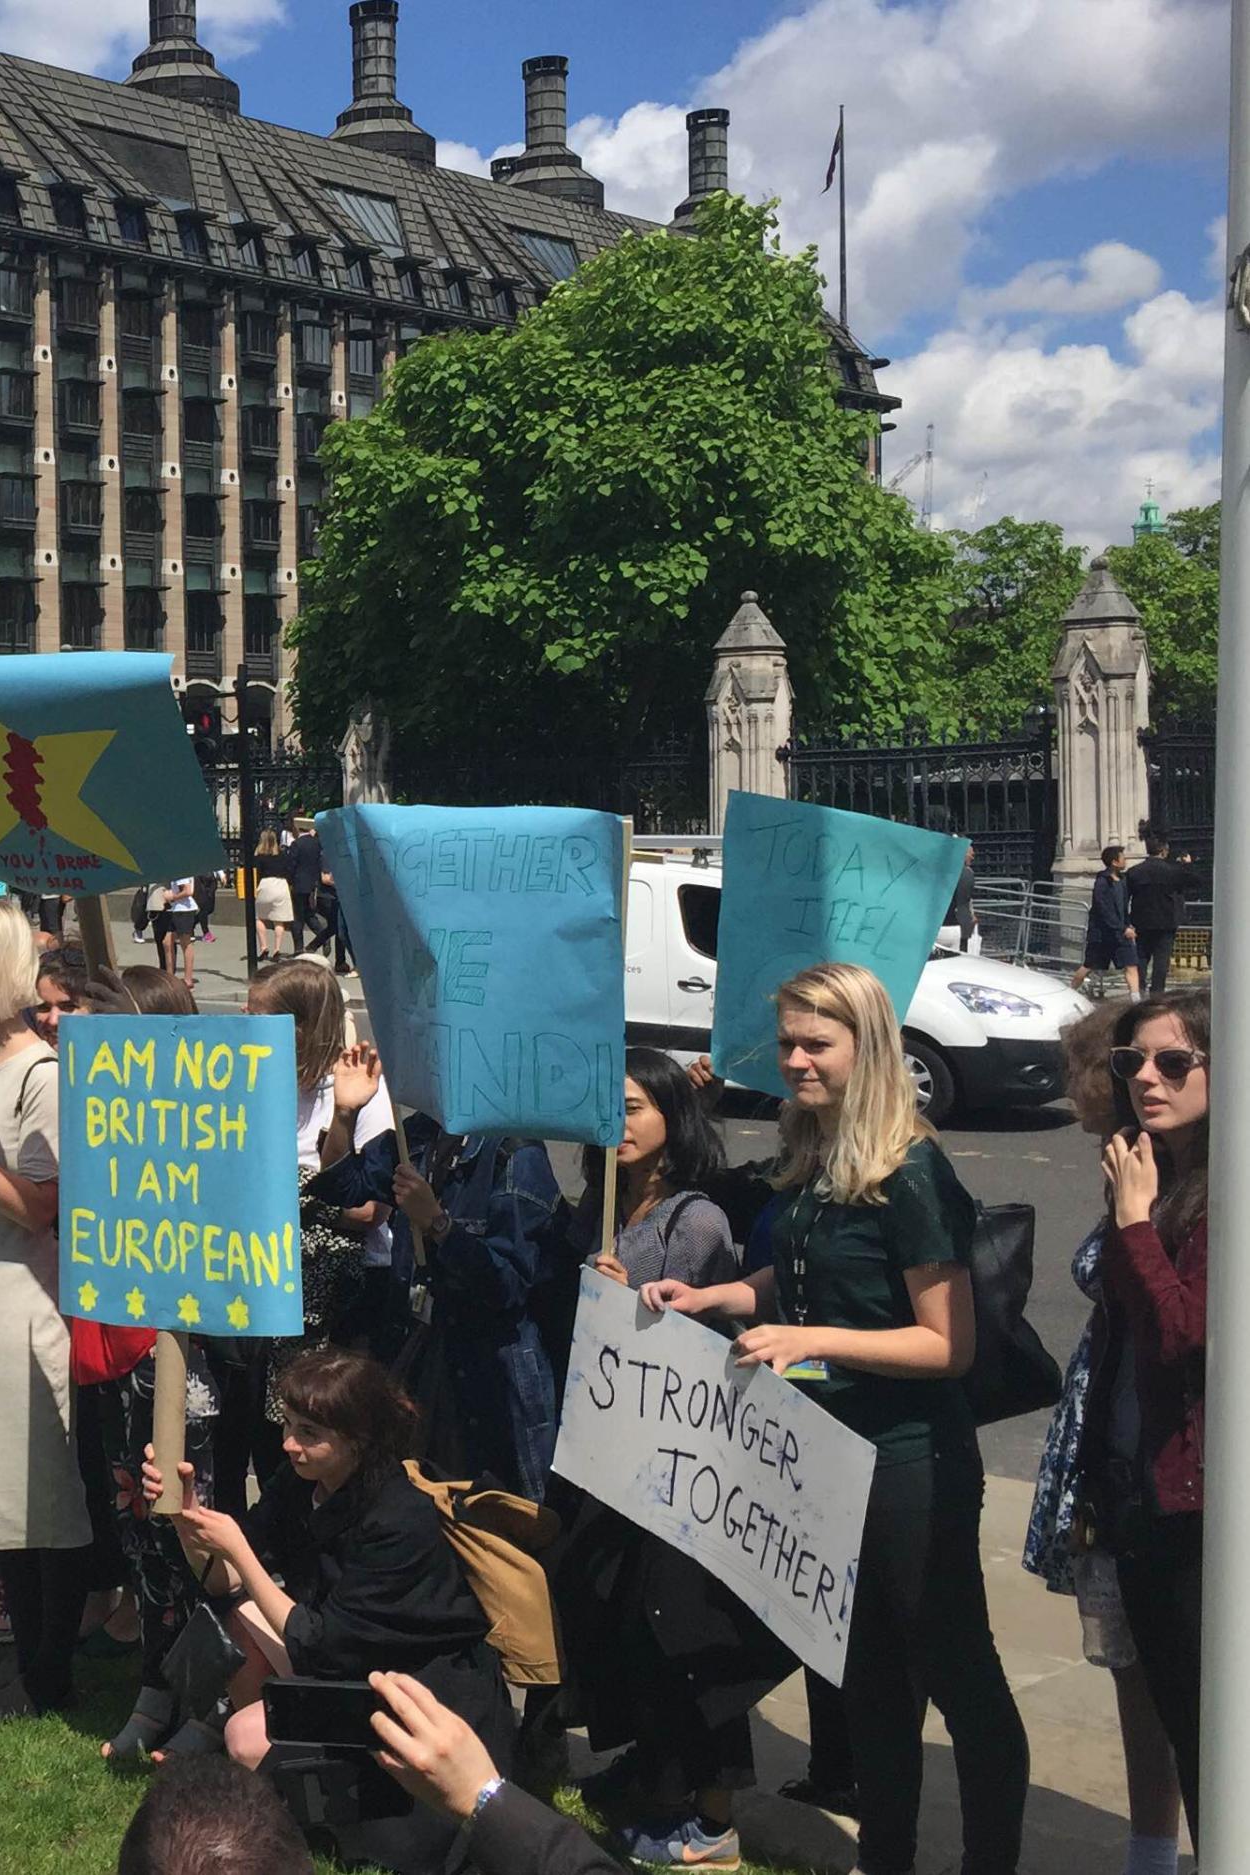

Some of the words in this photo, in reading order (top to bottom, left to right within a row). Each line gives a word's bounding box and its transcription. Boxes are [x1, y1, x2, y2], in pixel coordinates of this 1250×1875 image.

[0, 854, 35, 869] YOU
[56, 854, 102, 872] BROKE
[15, 876, 39, 887] MY
[46, 876, 85, 890] STAR
[746, 819, 921, 896] TODAY
[784, 897, 823, 937] I
[825, 898, 899, 962] FEEL
[68, 1040, 76, 1087] I
[87, 1039, 156, 1090] AM
[174, 1037, 273, 1092] NOT
[86, 1096, 248, 1151] BRITISH
[109, 1157, 118, 1198] I
[136, 1158, 199, 1205] AM
[70, 1207, 296, 1294] EUROPEAN!
[588, 1346, 803, 1492] STRONGER
[657, 1447, 858, 1642] TOGETHER!
